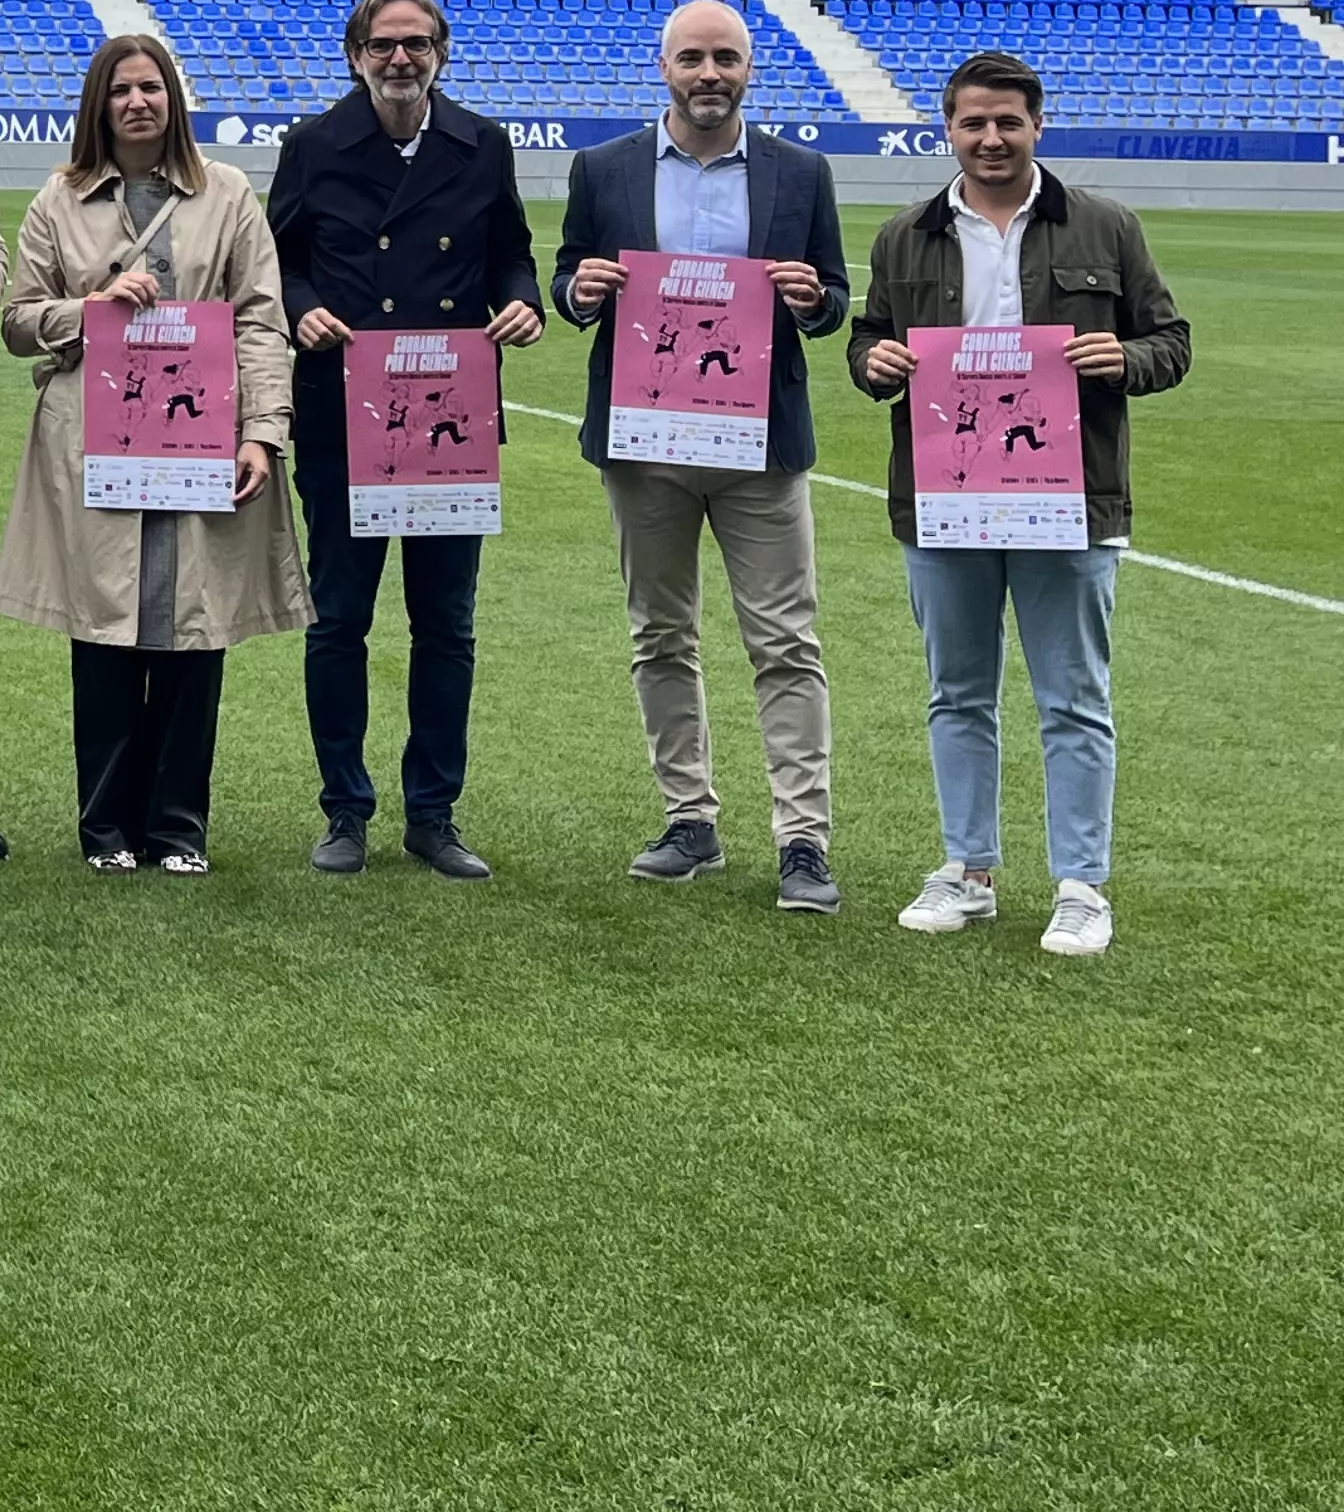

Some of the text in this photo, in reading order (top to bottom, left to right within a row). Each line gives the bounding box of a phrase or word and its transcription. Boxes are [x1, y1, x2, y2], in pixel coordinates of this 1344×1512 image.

[500, 122, 569, 148] BAR
[680, 278, 694, 298] LA
[145, 325, 157, 343] LA
[406, 354, 418, 373] LA
[976, 352, 990, 372] LA
